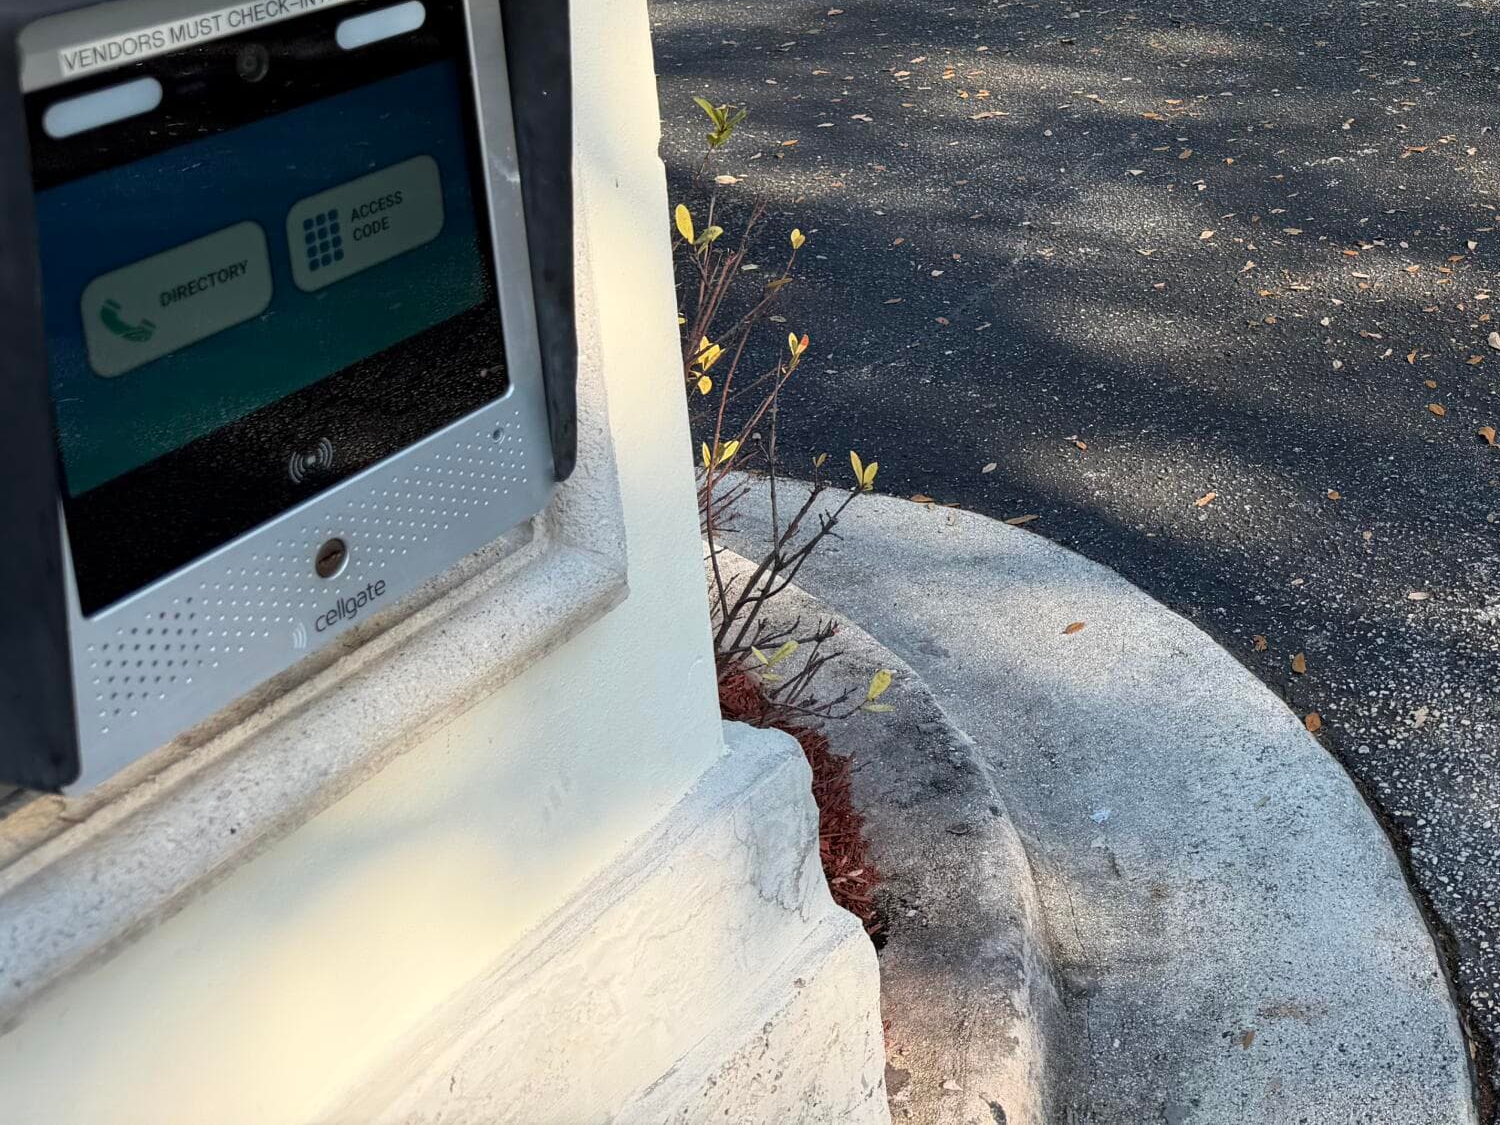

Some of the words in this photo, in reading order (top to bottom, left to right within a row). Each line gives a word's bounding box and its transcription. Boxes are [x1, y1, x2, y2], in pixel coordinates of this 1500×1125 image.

[63, 30, 166, 71] VENDORS
[170, 16, 223, 44] MUST
[350, 190, 404, 221] ACCESS
[352, 217, 391, 243] CODE
[159, 259, 249, 307] DIRECTORY
[315, 579, 386, 632] cellgate
